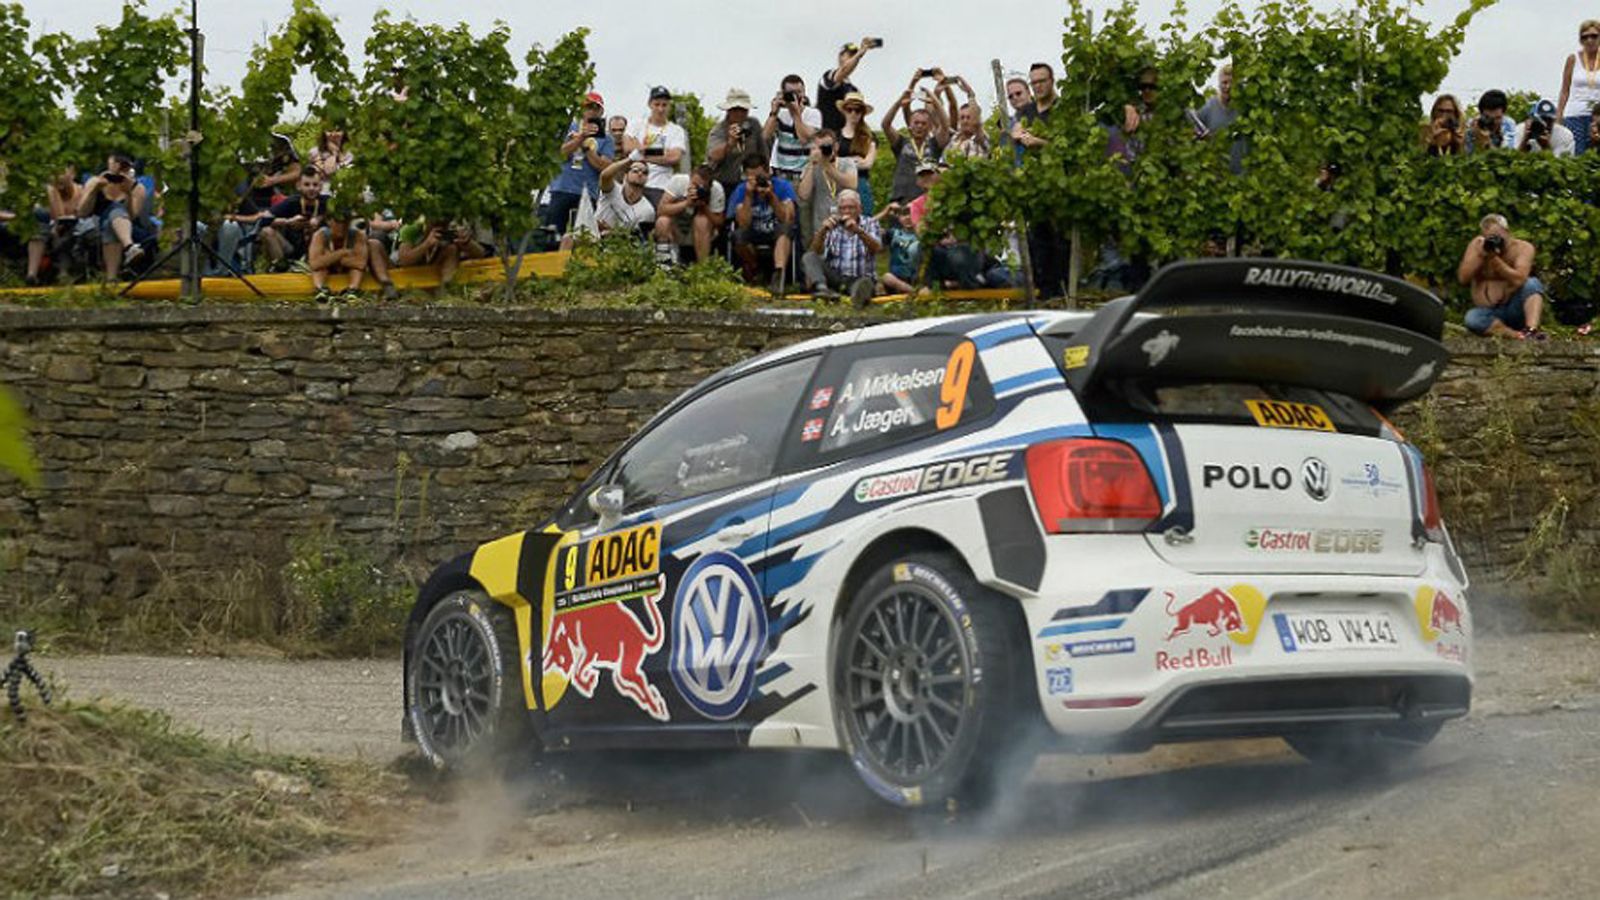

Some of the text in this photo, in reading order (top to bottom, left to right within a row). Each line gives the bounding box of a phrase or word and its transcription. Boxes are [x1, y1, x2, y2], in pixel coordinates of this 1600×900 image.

[838, 367, 946, 403] A. Mikkelsen
[936, 340, 976, 430] 9
[830, 414, 849, 437] A.
[1257, 402, 1326, 428] ADAC
[869, 452, 1015, 498] Castrol EDGE
[1203, 465, 1292, 490] POLO
[590, 526, 656, 582] ADAC
[1259, 528, 1386, 554] Castrol EDGE
[564, 545, 578, 591] 9
[1291, 618, 1398, 644] WOB VW 141
[1155, 644, 1232, 670] Red Bull
